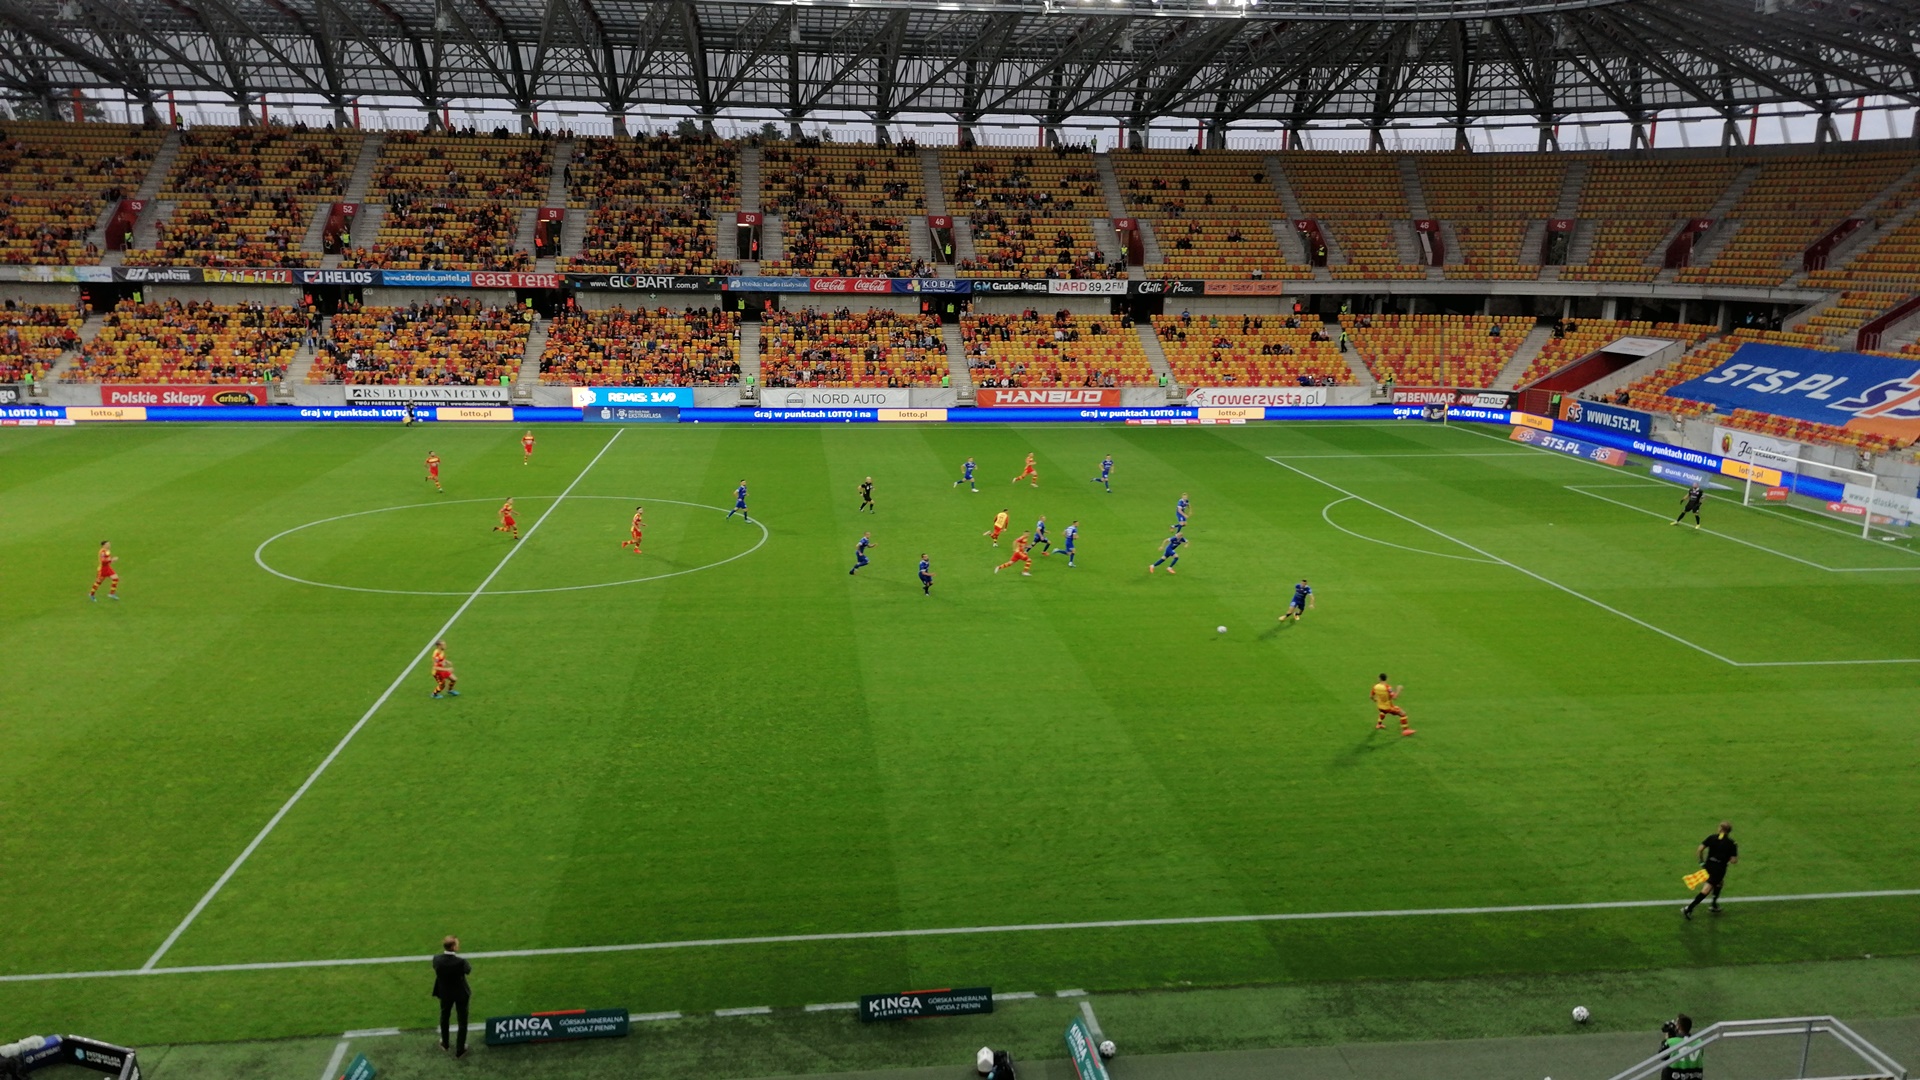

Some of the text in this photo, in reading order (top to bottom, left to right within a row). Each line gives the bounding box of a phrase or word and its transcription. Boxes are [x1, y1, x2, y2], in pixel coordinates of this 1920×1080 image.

[131, 202, 141, 210] 53
[343, 205, 353, 213] 52
[549, 210, 557, 218] 51
[935, 218, 945, 226] 49
[1119, 220, 1128, 228] 48
[1699, 221, 1708, 229] 44
[219, 270, 286, 282] 7 11 11 11
[325, 271, 372, 283] HELIOS
[384, 273, 470, 284] www.zdrowie.mitel.pl
[475, 273, 555, 287] east rent
[973, 281, 991, 291] GM
[1056, 280, 1087, 291] JARD
[1088, 282, 1111, 292] 89,2
[1172, 281, 1194, 293] Pizza
[1704, 364, 1849, 400] STS.PL
[112, 392, 206, 406] Polskie Sklepy
[219, 394, 248, 403] arhela
[364, 389, 501, 398] RS BUDOWNICTWO
[812, 394, 886, 404] NORD AUTO
[995, 390, 1103, 403] HANBUD
[1211, 391, 1319, 407] rowerzysta.pl
[1407, 392, 1455, 403] BENMAR
[8, 409, 37, 417] LOTTO
[90, 410, 123, 418] lotto.pl
[300, 409, 320, 418] Graj
[333, 409, 379, 418] punktach
[381, 409, 408, 417] LOTTO
[460, 410, 492, 418] lotto.pl
[754, 411, 772, 419] Graj
[784, 410, 826, 418] punktach
[899, 411, 928, 419] lotto.pl
[1080, 410, 1098, 418] Graj
[1109, 410, 1148, 418] punktach
[1587, 410, 1641, 433] WWW.STS.PL
[1541, 436, 1581, 454] STS.PL
[1590, 447, 1611, 461] STS
[1633, 441, 1646, 451] Graj
[1652, 445, 1682, 459] punktach
[1683, 450, 1703, 463] LOTTO
[1707, 458, 1717, 467] na
[869, 996, 922, 1012] KINGA
[495, 1017, 552, 1033] KINGA
[1070, 1023, 1087, 1061] KINGA
